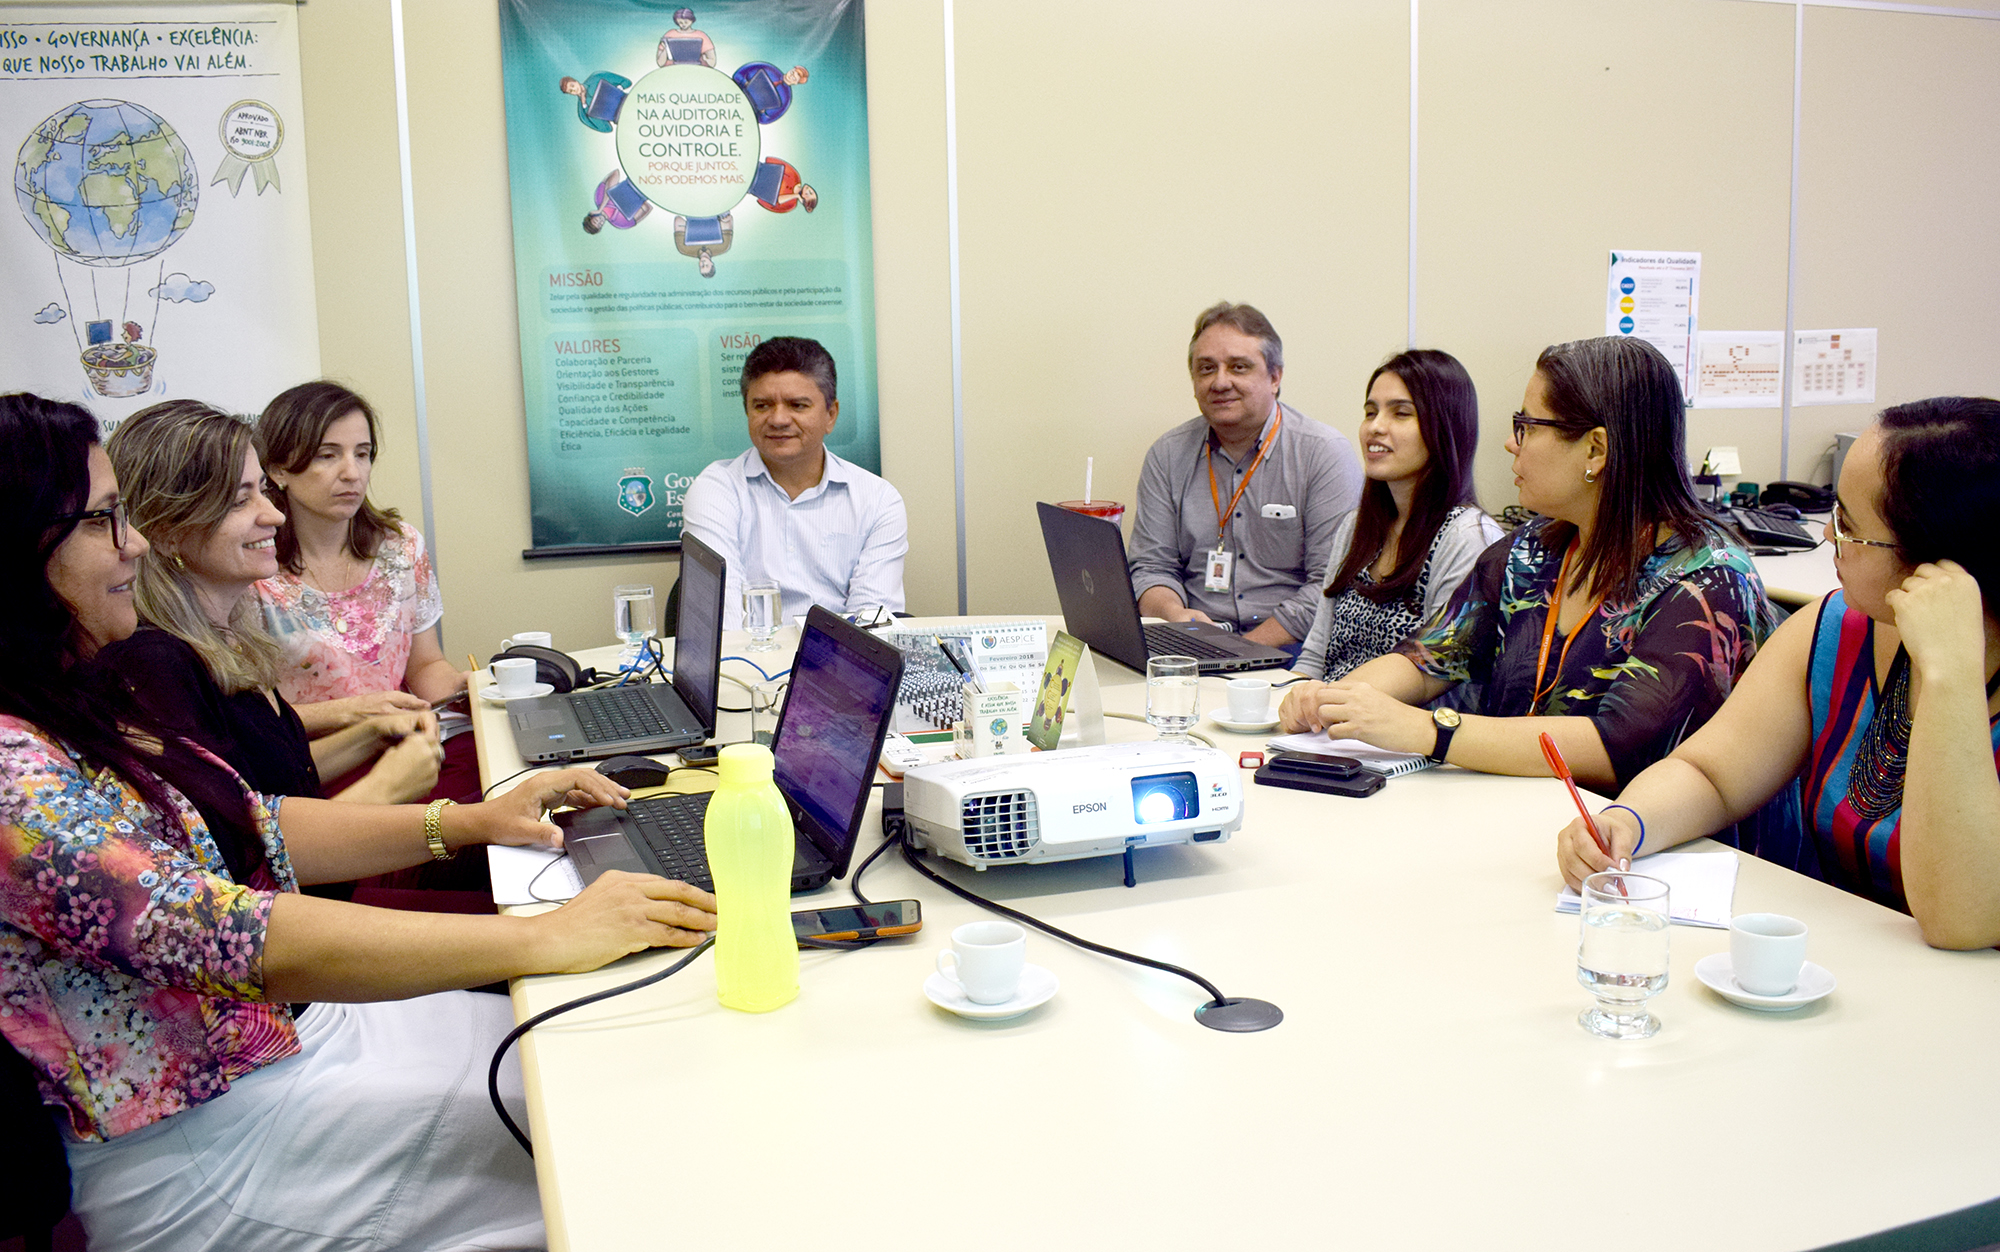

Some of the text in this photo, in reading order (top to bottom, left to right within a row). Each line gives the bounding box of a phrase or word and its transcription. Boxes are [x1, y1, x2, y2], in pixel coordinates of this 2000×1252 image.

[47, 28, 150, 51] GOVERNANÇA
[169, 27, 259, 47] EXCELÊNCIA:
[3, 51, 252, 74] QUE NOSSO TRABALHO VAI ALÉM.
[637, 93, 741, 105] MAIS QUALIDADE
[237, 112, 269, 122] APROVADO
[637, 108, 745, 122] NA AUDITORIA,
[234, 126, 268, 139] ABNT NBR
[638, 124, 743, 138] OUVIDORIA E
[229, 135, 240, 144] ISO
[638, 142, 742, 157] CONTROLE.
[648, 161, 739, 173] PORQUE JUNTOS,
[638, 173, 746, 185] NÓS PODEMOS MAIS.
[1621, 256, 1656, 264] Indicadores
[1666, 257, 1697, 265] Qualidade
[549, 269, 603, 287] MISSÃO
[554, 338, 621, 354] VALORES
[719, 331, 761, 349] VISÃO
[555, 357, 608, 368] Colaboração
[617, 355, 652, 365] Parceria
[720, 352, 734, 362] Ser
[556, 369, 602, 380] Orientação
[621, 368, 660, 378] Gestores
[556, 381, 607, 392] Visibilidade
[615, 378, 675, 390] Transparência
[557, 393, 600, 404] Confiança
[609, 391, 665, 402] Credibilidade
[558, 403, 648, 416] Qualidade das Ações
[559, 415, 610, 428] Capacidade
[618, 413, 676, 426] Competência
[560, 425, 691, 440] Eficiência, Eficácia e Legalidade
[560, 440, 582, 452] Ética
[1072, 801, 1107, 815] EPSON
